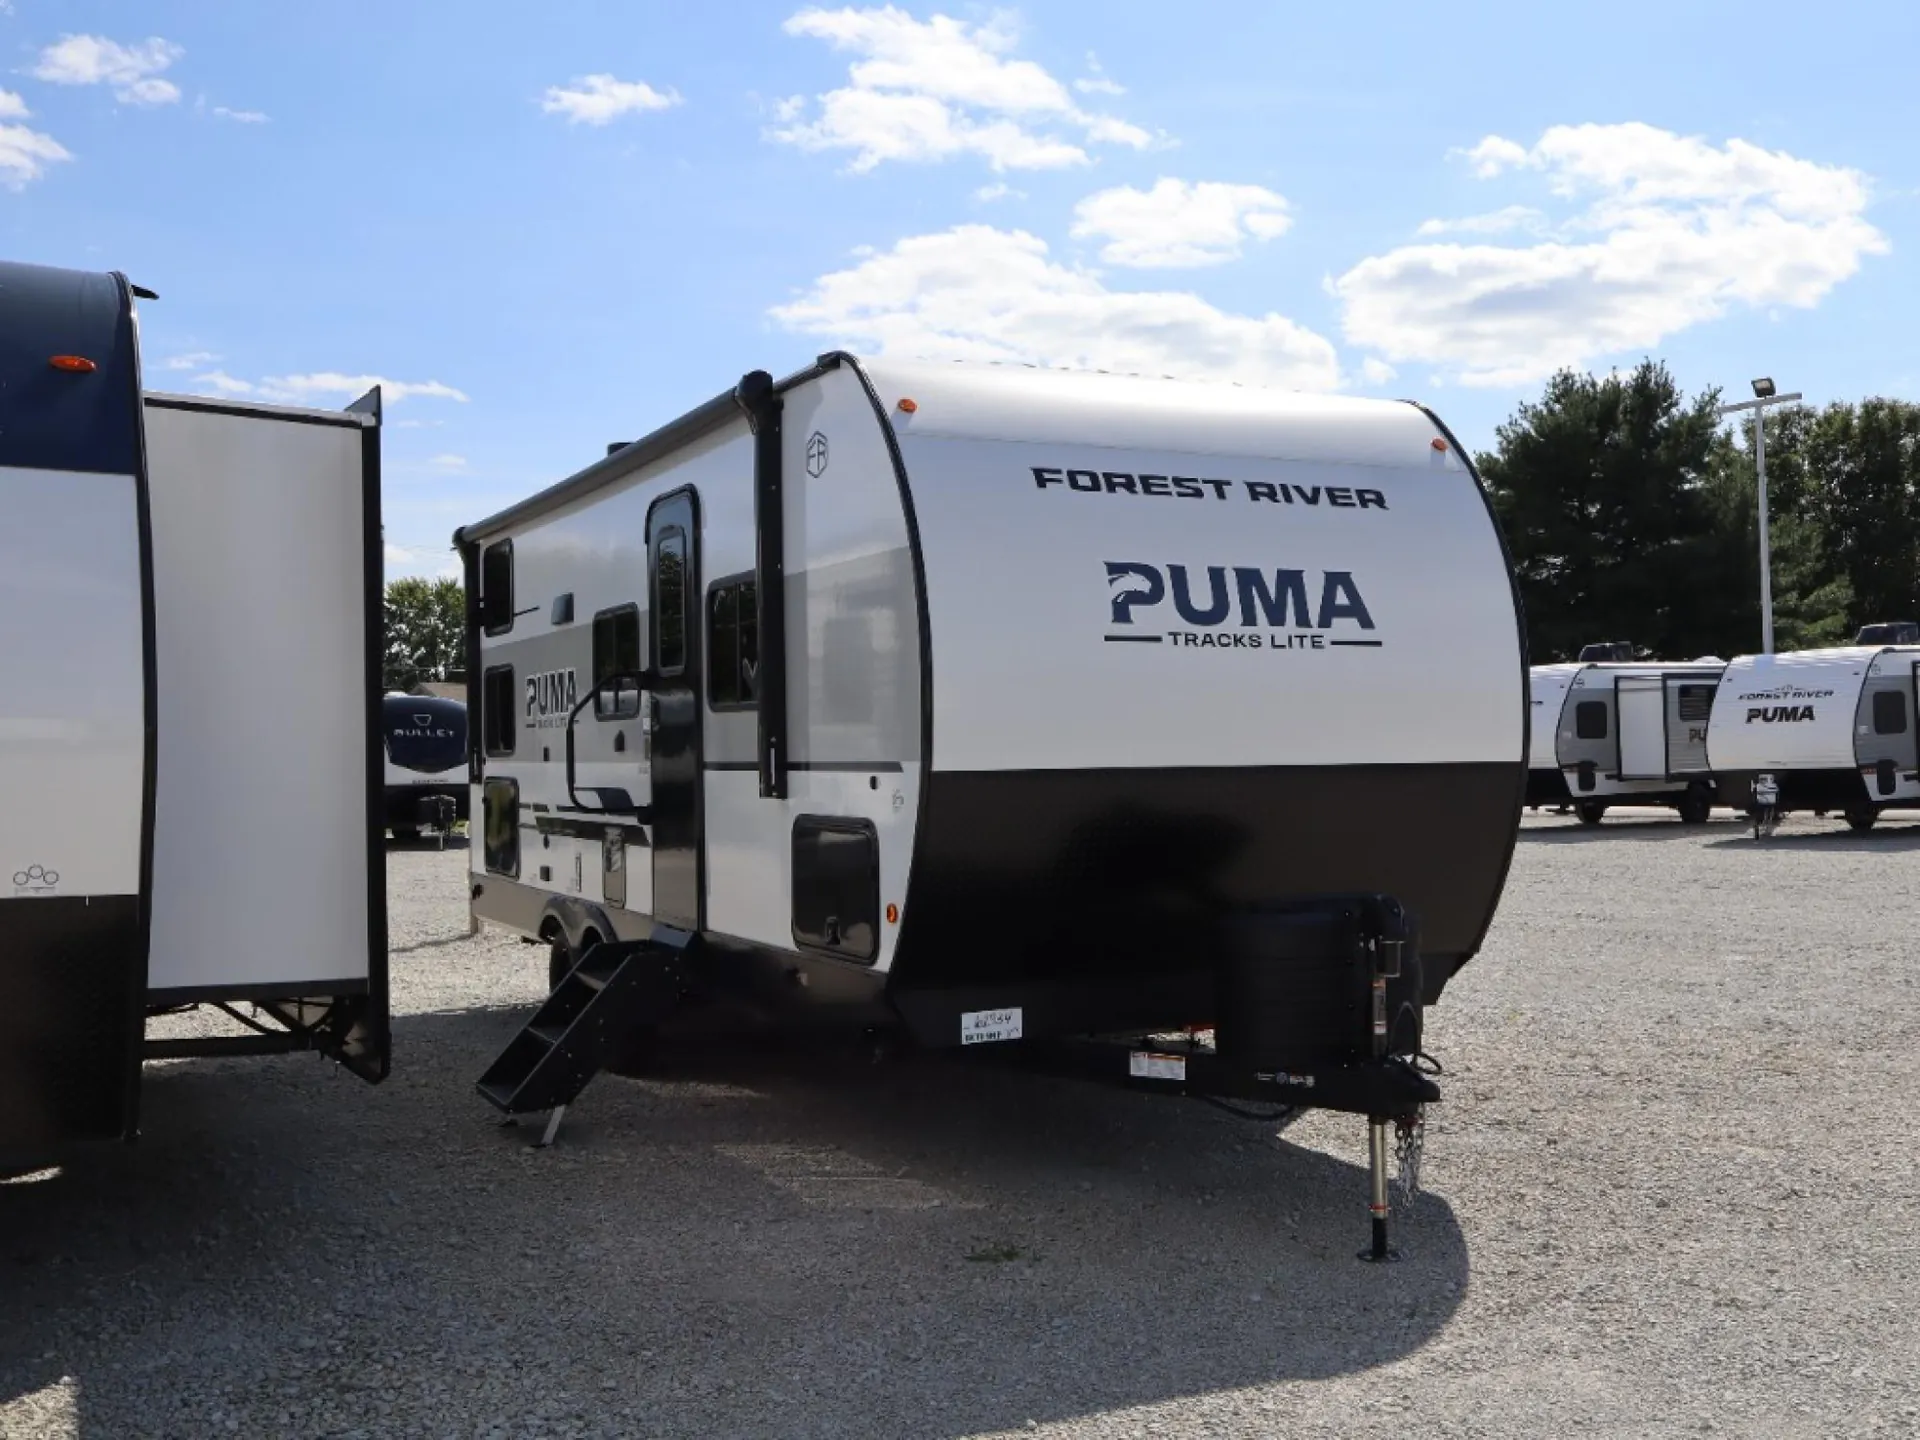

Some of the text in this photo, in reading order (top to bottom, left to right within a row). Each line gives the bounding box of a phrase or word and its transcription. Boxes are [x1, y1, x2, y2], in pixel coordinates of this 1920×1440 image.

[1030, 467, 1389, 510] FOREST RIVER
[1103, 560, 1375, 629] PUMA
[1168, 631, 1326, 649] TRACKS LITE
[526, 669, 577, 717] PUMA
[1738, 689, 1834, 700] FOREST RIVER
[1745, 704, 1815, 724] PUMA
[1688, 728, 1706, 743] PU
